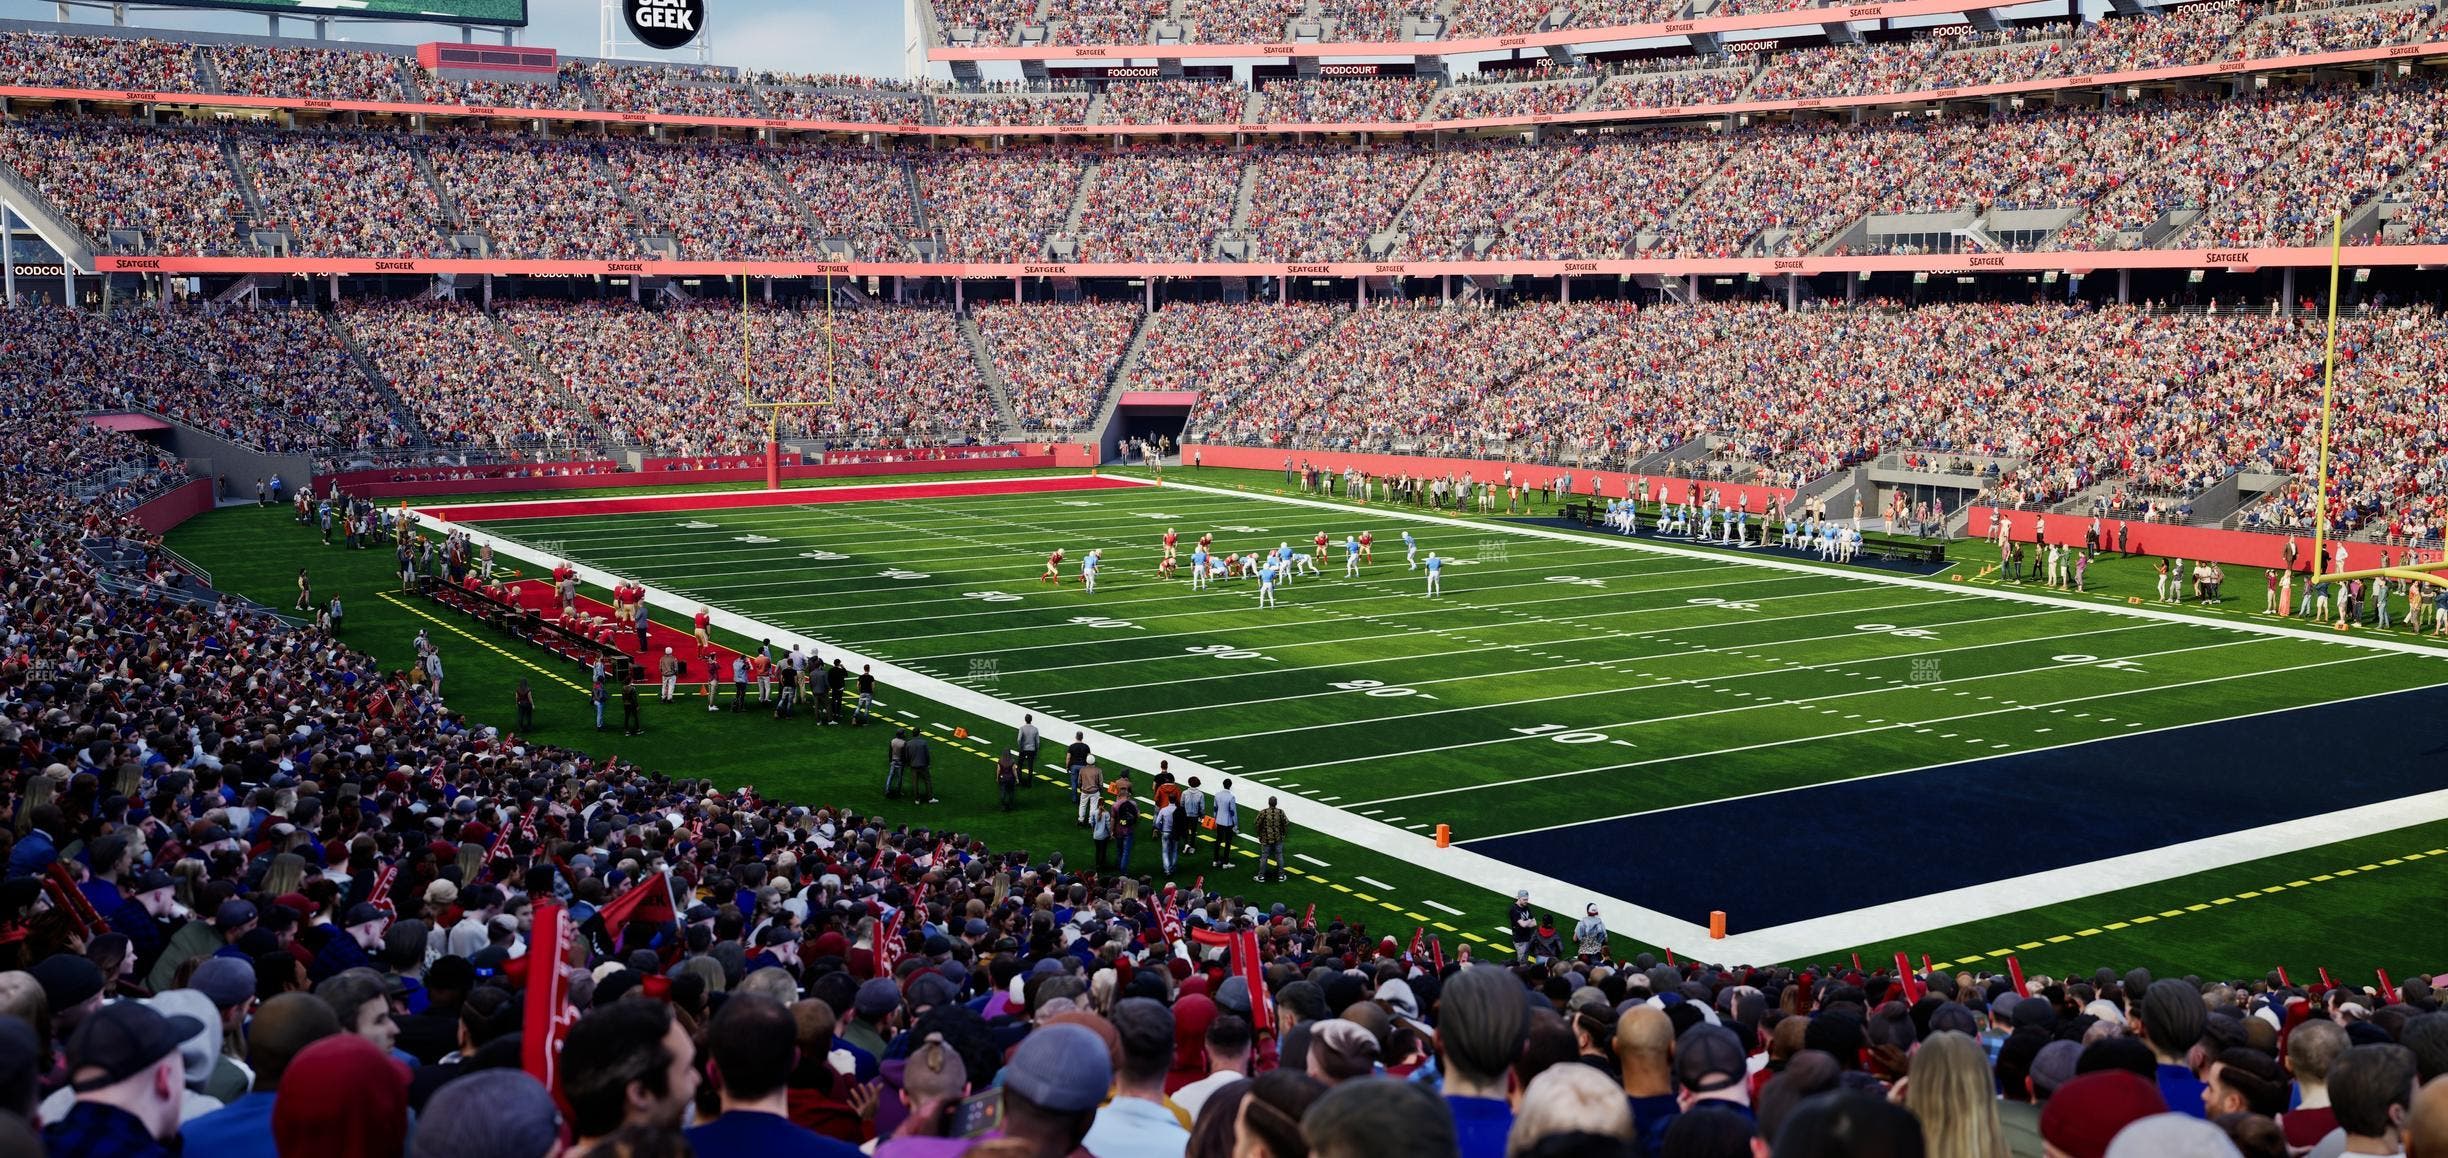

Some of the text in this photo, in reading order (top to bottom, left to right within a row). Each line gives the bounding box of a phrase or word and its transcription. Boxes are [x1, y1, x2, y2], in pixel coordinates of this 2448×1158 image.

[1850, 8, 1881, 16] SEATGEEK
[635, 7, 694, 31] GEEK
[1500, 38, 1526, 46] SEATGEEK
[1722, 41, 1779, 51] FOODCOURT
[2390, 47, 2419, 55] SEATGEEK
[1108, 69, 1160, 77] FOODCOUR
[1321, 66, 1377, 74] FOODCOURT
[1970, 258, 2004, 266] SEATGEEK
[2207, 253, 2248, 263] SEATGEEK
[116, 260, 159, 268] SEATGEEK
[376, 262, 414, 270] SEATGEEK
[608, 263, 642, 271] SEATGEEK
[1565, 263, 1597, 271] SEATGEEK
[1775, 260, 1803, 269] SEATGEEK
[1510, 724, 1609, 744] 10
